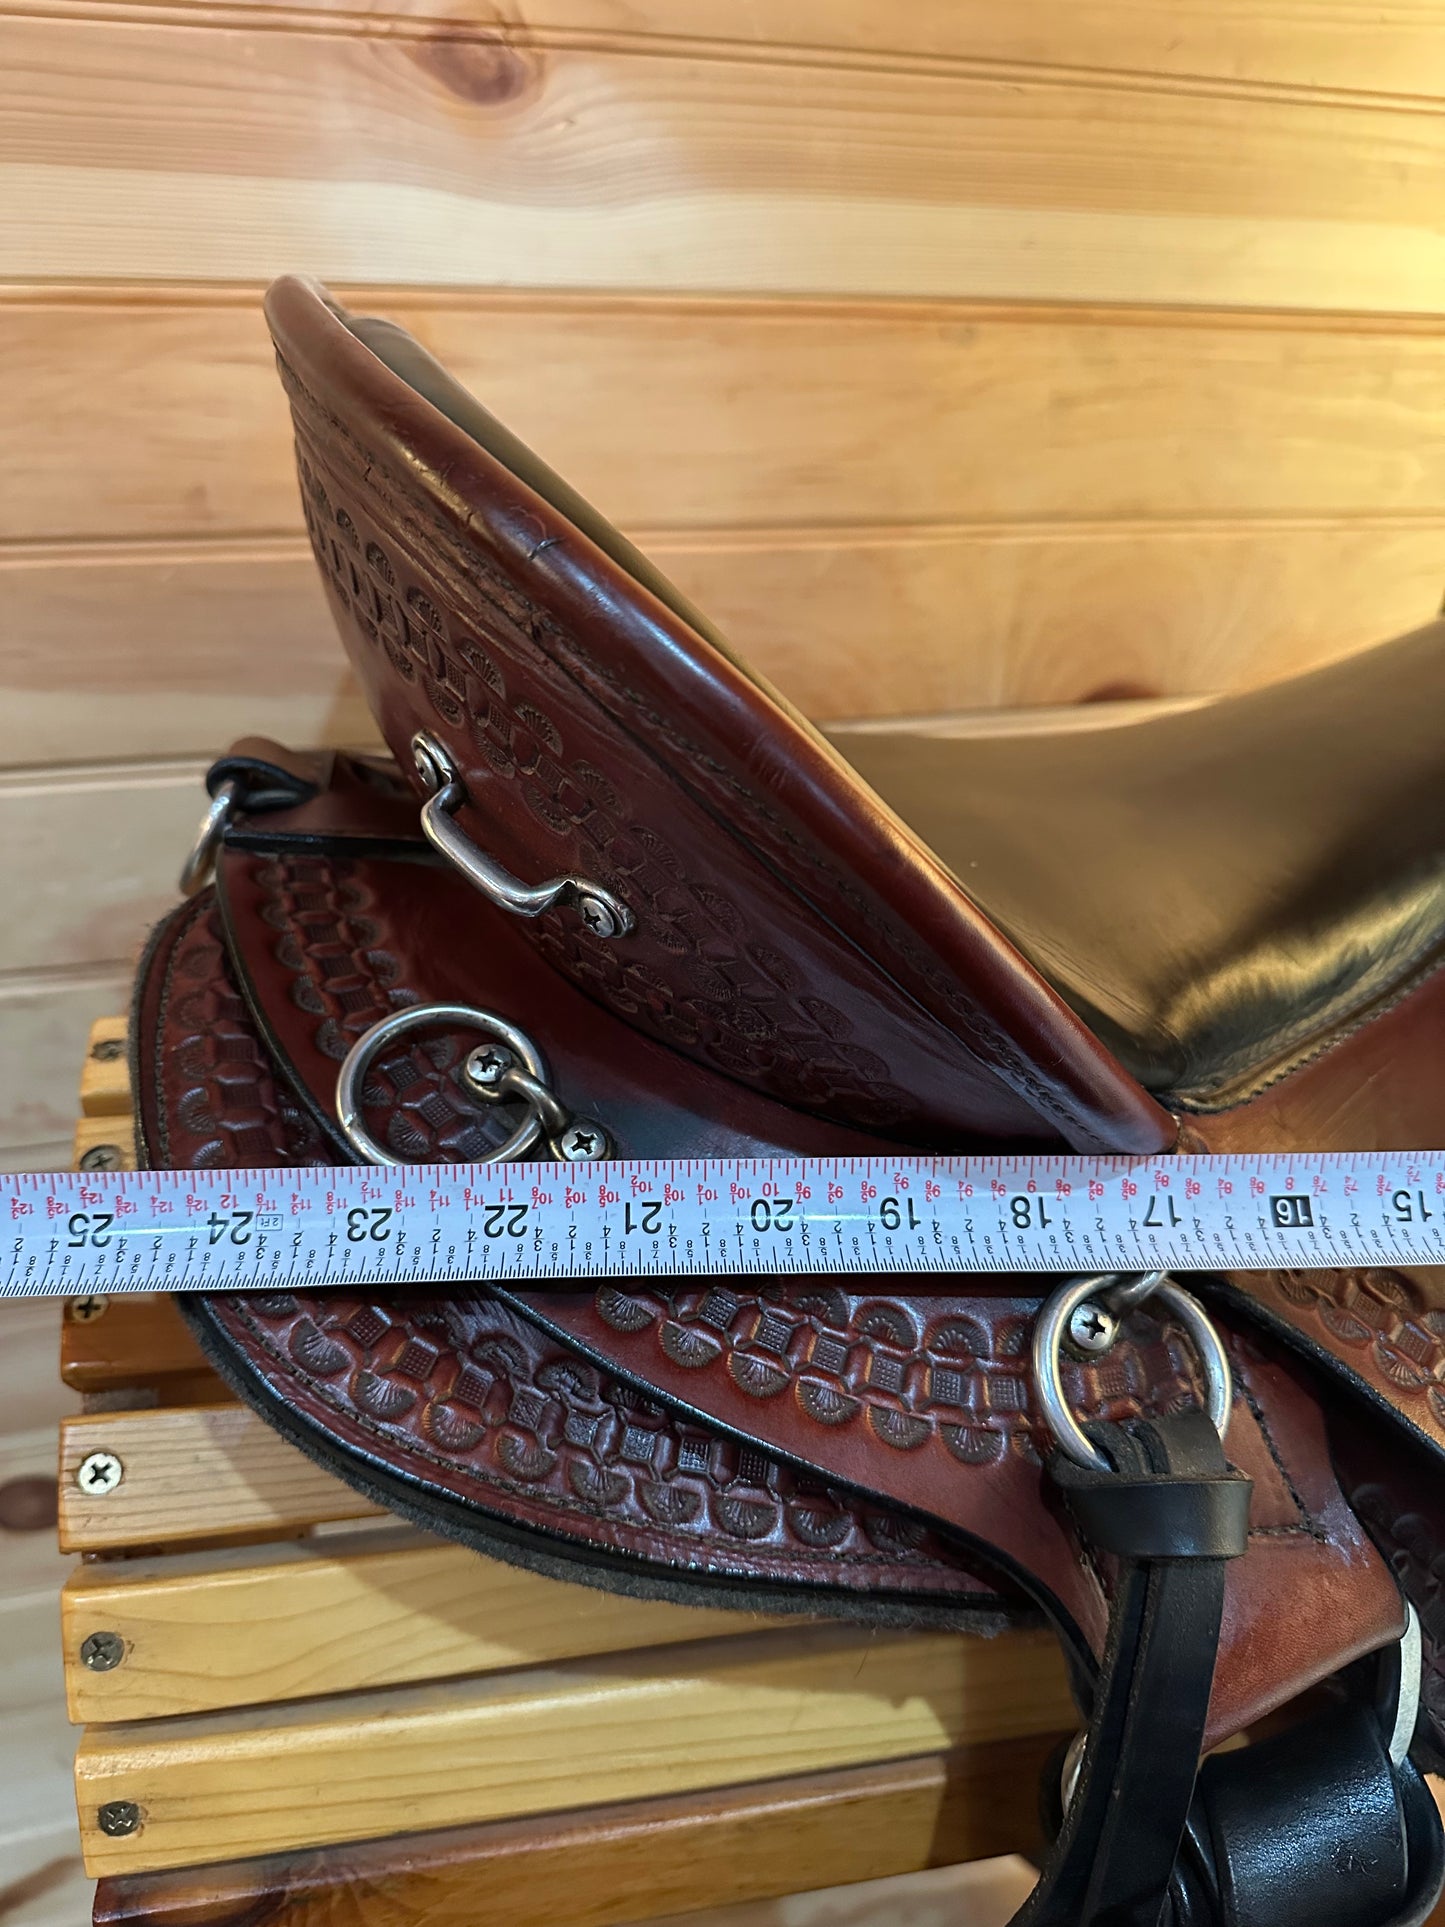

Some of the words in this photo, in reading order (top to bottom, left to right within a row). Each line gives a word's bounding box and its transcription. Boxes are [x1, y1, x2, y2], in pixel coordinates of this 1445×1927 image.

[261, 1217, 271, 1227] Ft
[272, 1217, 279, 1227] 2
[482, 1205, 528, 1238] 22
[624, 1202, 661, 1234] 21
[751, 1200, 793, 1232] 20
[880, 1197, 921, 1230] 19
[1010, 1196, 1052, 1229] 18
[1143, 1196, 1182, 1227] 17
[1276, 1198, 1310, 1224] 16
[1392, 1190, 1432, 1222] 15
[68, 1213, 114, 1247] 25
[207, 1211, 253, 1244] 24
[348, 1208, 392, 1242] 23
